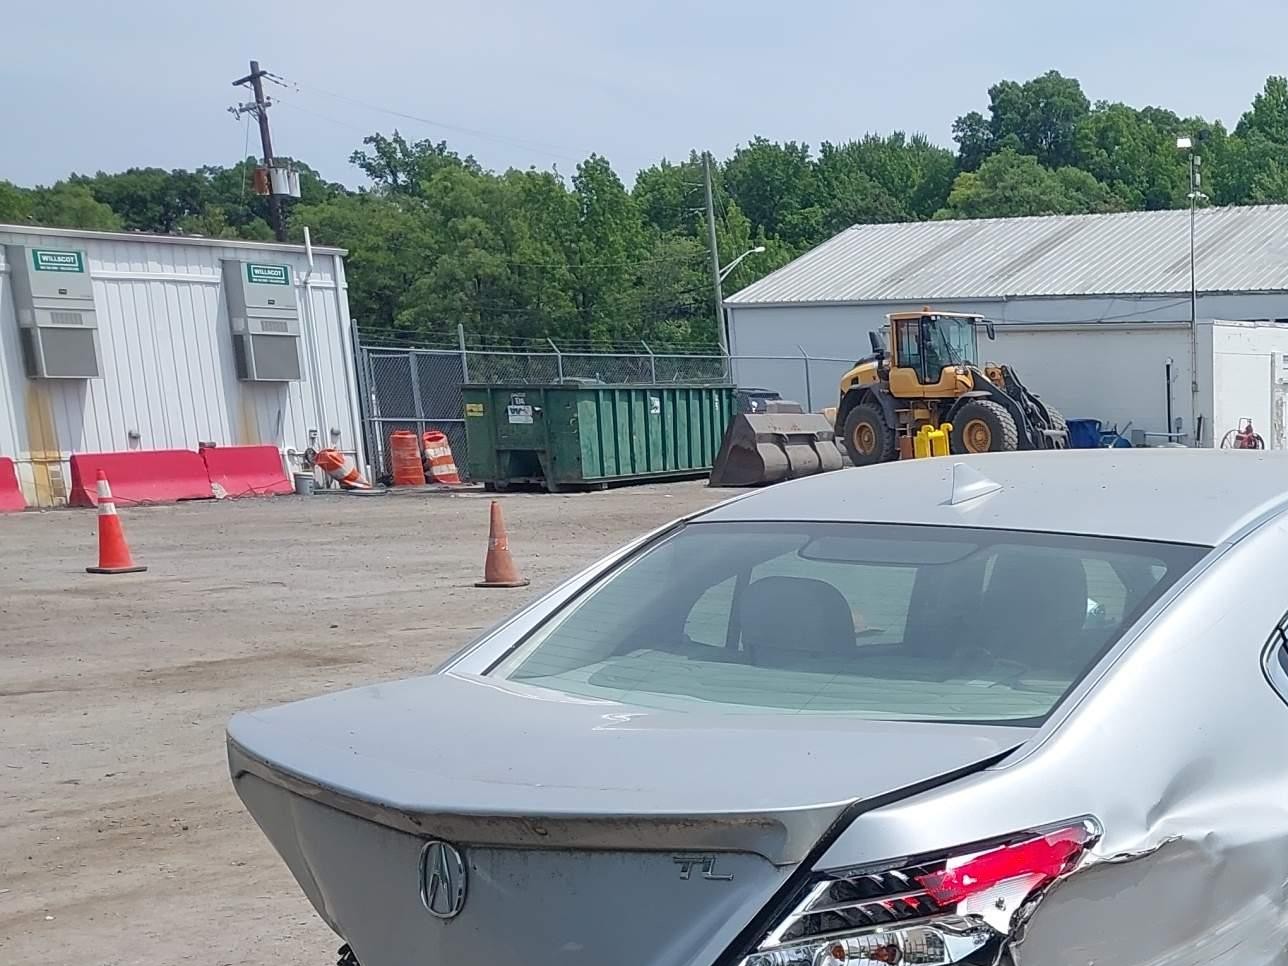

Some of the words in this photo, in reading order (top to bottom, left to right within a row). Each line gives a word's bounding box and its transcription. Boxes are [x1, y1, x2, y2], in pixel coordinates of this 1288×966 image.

[41, 255, 75, 263] WILLSCOT
[254, 268, 282, 276] WILLSCOT
[673, 856, 735, 881] TL
